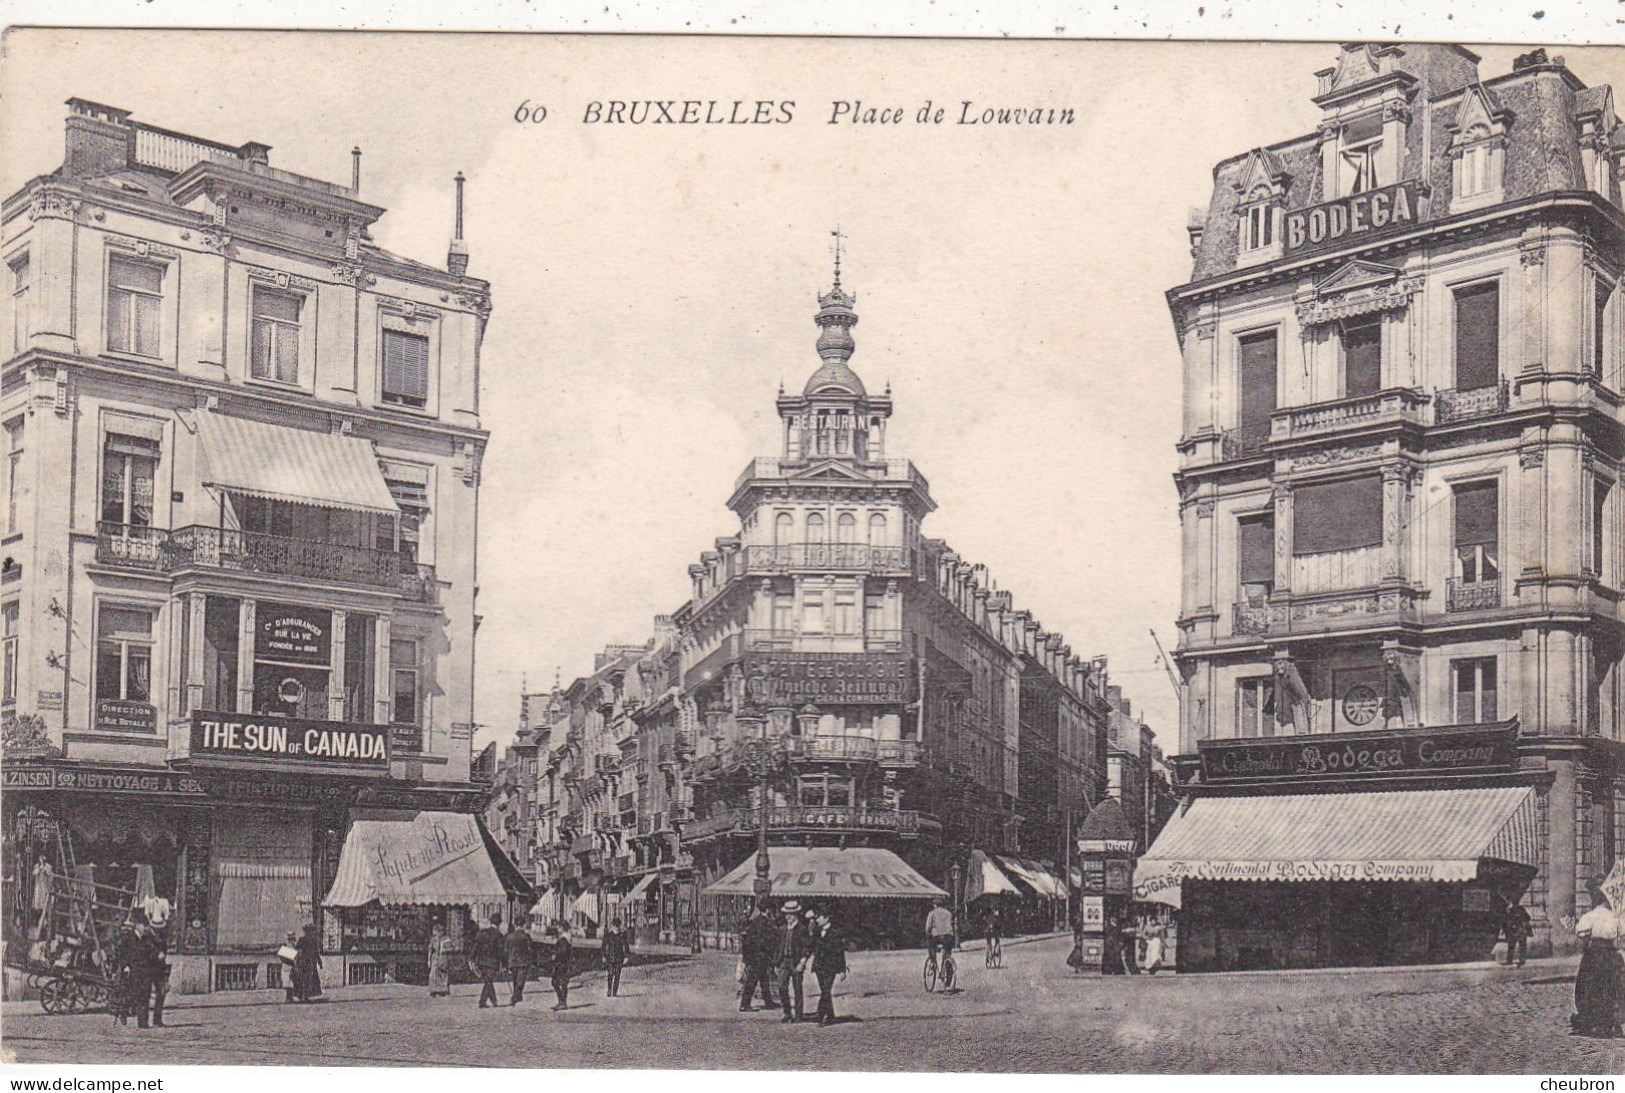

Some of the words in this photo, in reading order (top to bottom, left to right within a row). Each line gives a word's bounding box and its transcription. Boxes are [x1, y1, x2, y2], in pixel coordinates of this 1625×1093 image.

[1288, 186, 1411, 250] BODEGA
[291, 630, 300, 640] LA
[102, 704, 151, 716] DIRECTION
[201, 721, 241, 749] THE
[244, 723, 287, 753] SUN
[288, 742, 302, 754] OF
[304, 729, 386, 759] CANADA
[1296, 744, 1405, 774] Bodega
[1419, 740, 1494, 763] Company
[76, 773, 159, 790] NETTOYAGE
[1168, 861, 1193, 874] The
[1197, 860, 1272, 876] Continental
[1276, 860, 1357, 879] Bodega
[1363, 861, 1434, 879] Company
